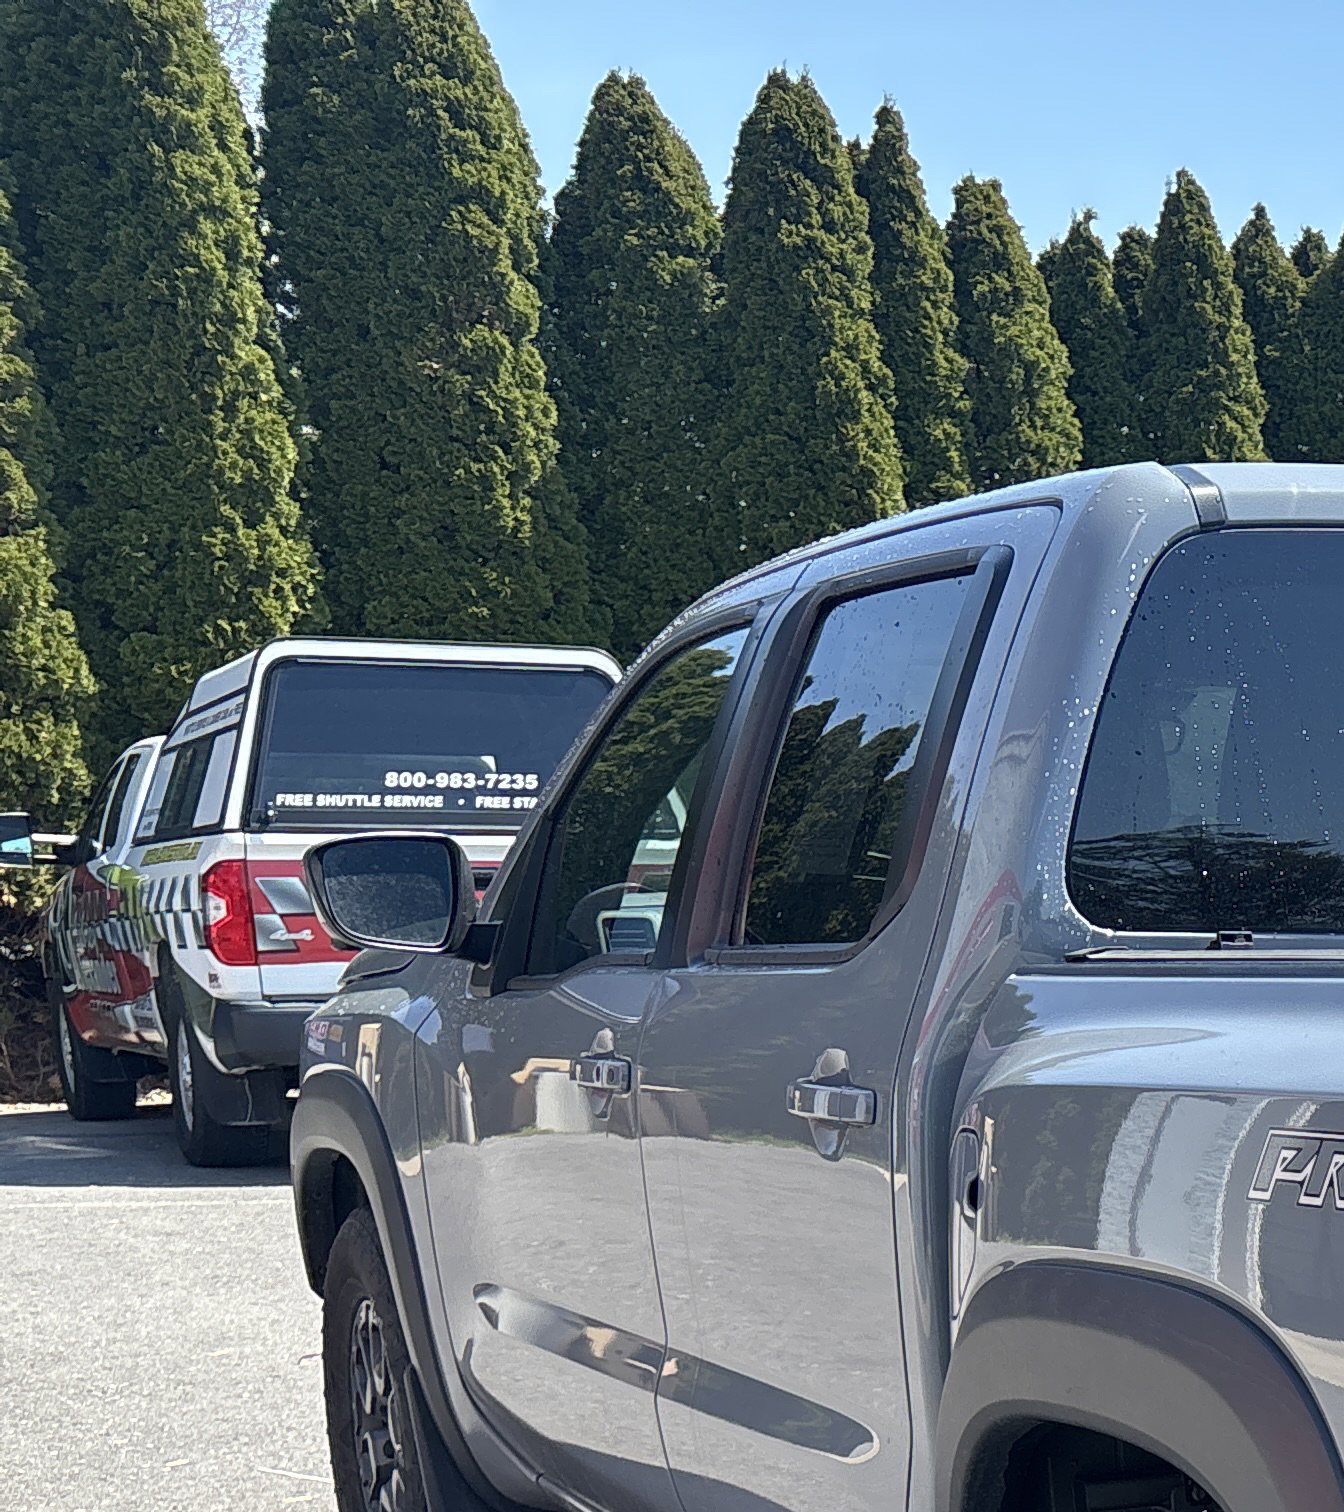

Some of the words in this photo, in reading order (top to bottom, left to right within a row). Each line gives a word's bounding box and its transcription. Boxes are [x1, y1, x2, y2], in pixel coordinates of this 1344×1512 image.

[384, 771, 539, 789] 800-983-7235
[276, 794, 313, 806] FREE
[316, 794, 382, 807] SHUTTLE
[384, 795, 444, 808] SERVICE
[475, 796, 511, 808] FREE
